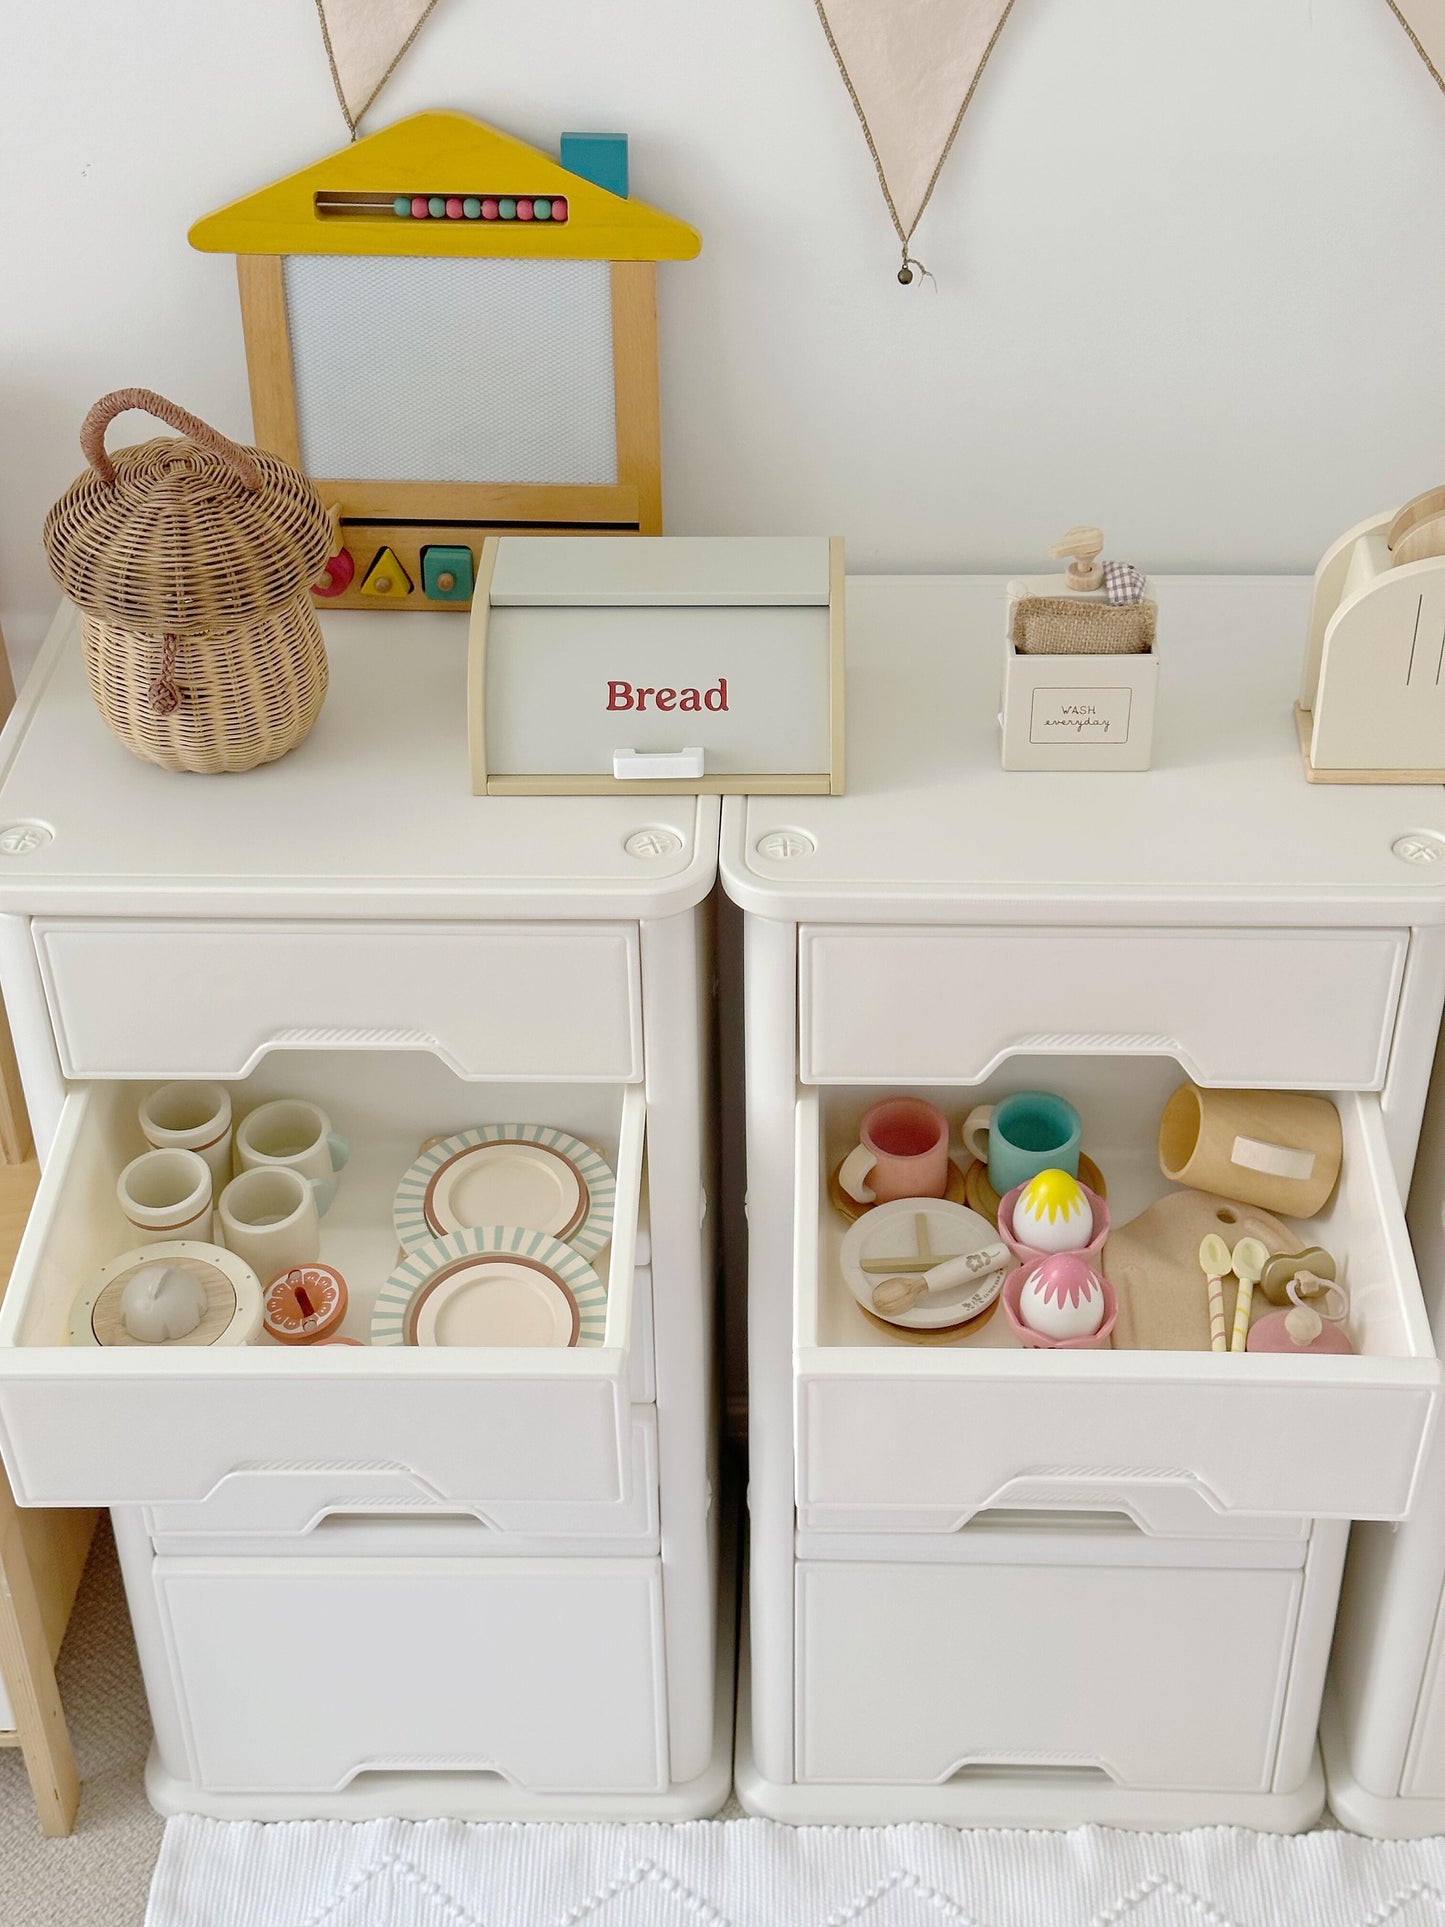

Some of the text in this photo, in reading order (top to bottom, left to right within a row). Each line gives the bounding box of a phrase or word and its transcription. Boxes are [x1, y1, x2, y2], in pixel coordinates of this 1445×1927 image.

[606, 678, 729, 711] Bread
[1061, 705, 1096, 715] WASH
[1044, 717, 1110, 732] everyday
